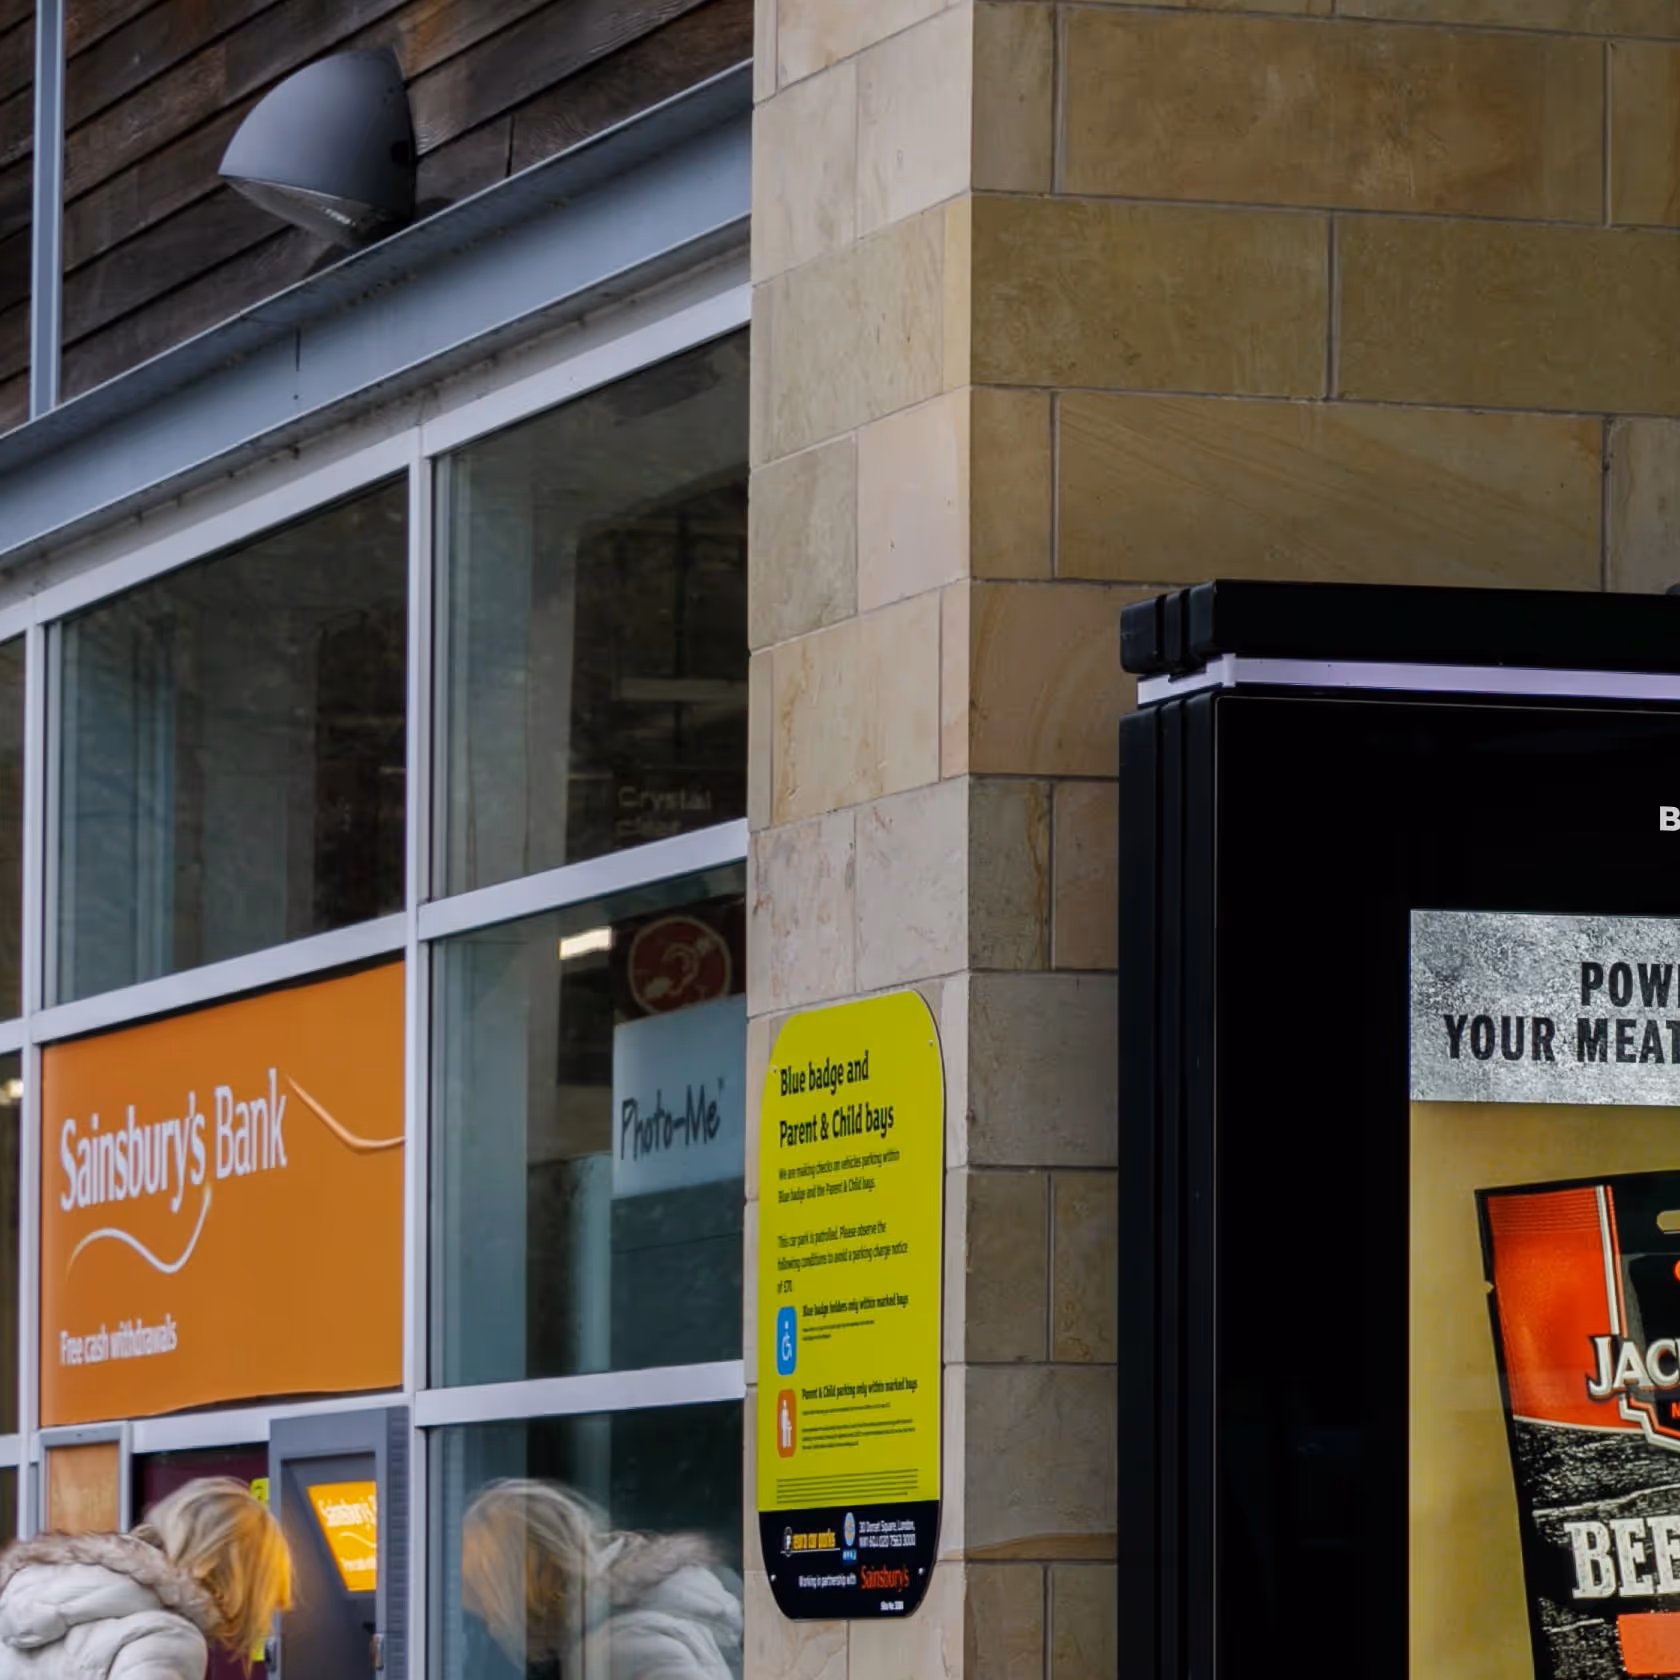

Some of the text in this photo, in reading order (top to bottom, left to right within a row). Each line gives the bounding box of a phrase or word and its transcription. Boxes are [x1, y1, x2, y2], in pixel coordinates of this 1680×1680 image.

[1445, 1014, 1555, 1061] YOUR
[780, 1049, 869, 1097] Blue badge and
[60, 1067, 288, 1213] Sainsbury's Bank
[621, 1084, 721, 1161] Photo-Me
[779, 1101, 894, 1148] Parent & Child bays
[60, 1314, 178, 1366] Free cash withdrawals
[860, 1563, 909, 1592] Sainsbury's
